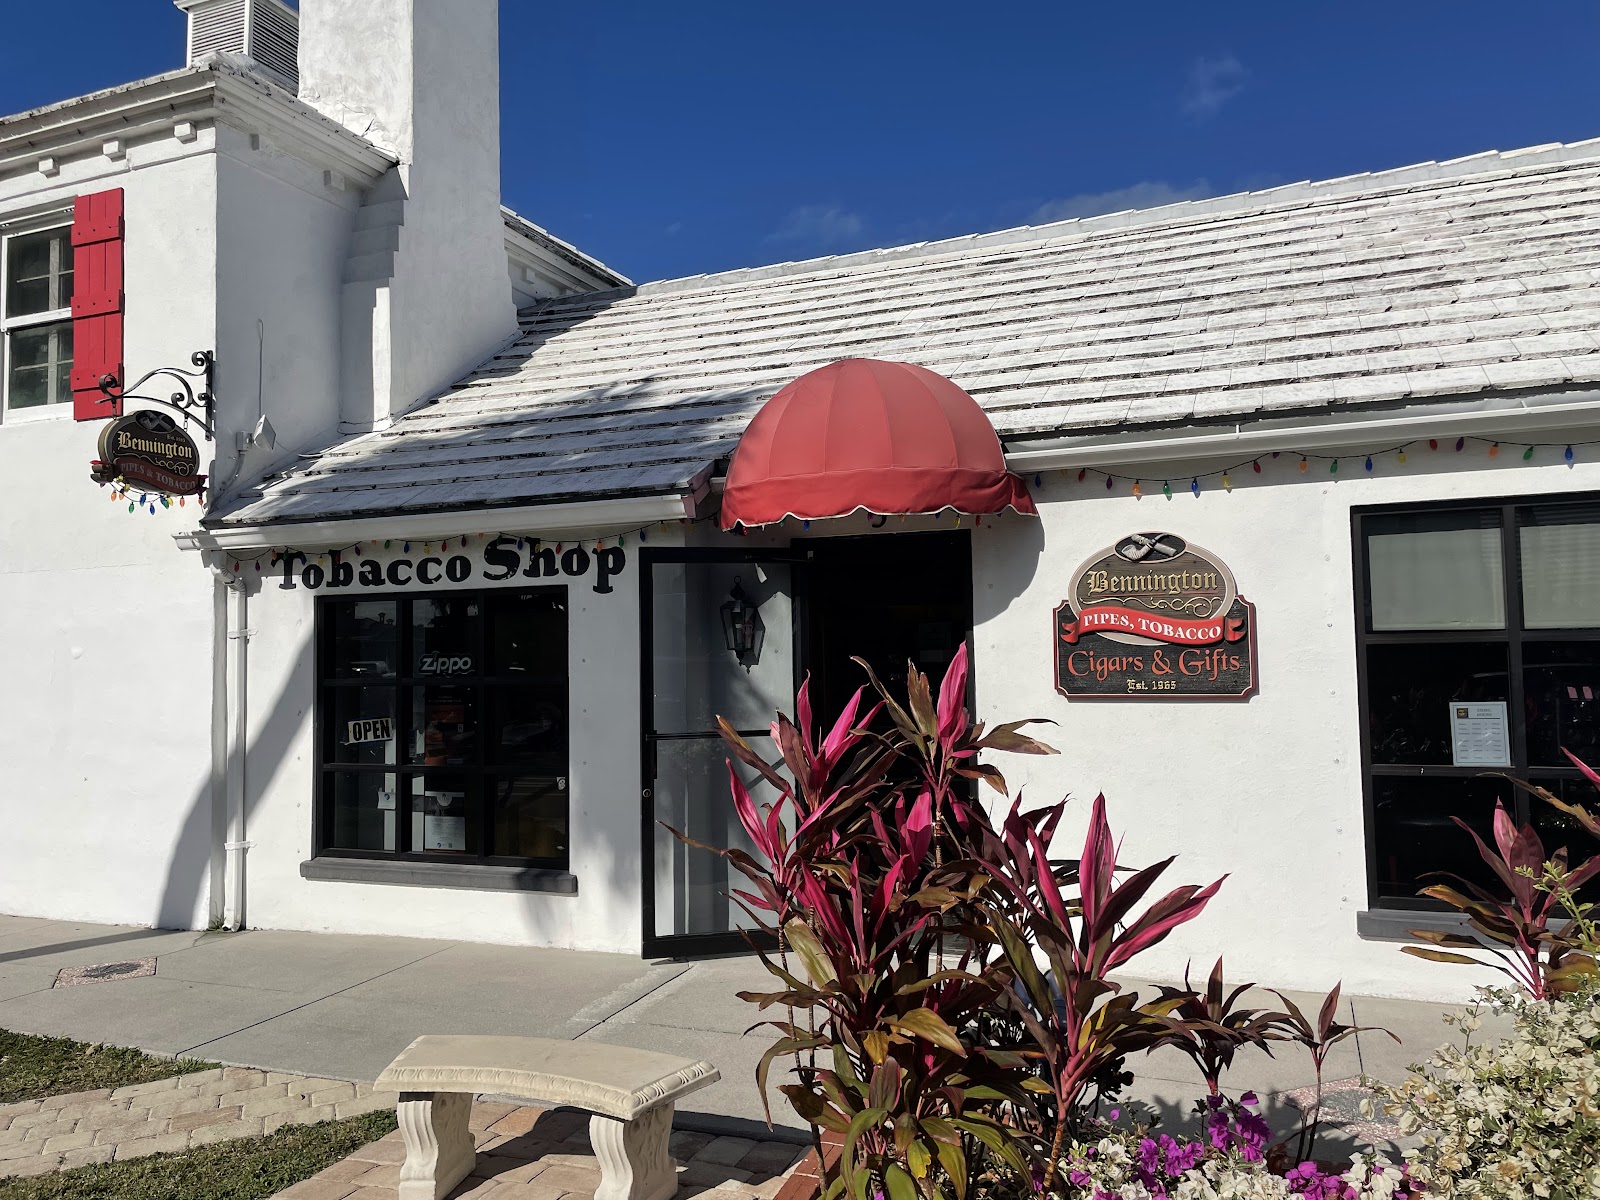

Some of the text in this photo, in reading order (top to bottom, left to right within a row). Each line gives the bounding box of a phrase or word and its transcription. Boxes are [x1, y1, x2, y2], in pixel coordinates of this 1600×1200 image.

[117, 431, 193, 458] Bennington
[120, 462, 196, 490] PIPES & TOBACCO
[270, 536, 626, 594] Tobacco Shop
[1086, 569, 1219, 597] Bennington
[1083, 612, 1222, 640] PIPES, TOBACCO
[1067, 648, 1241, 681] Cigars & Gifts
[1126, 678, 1177, 694] Est. 1965
[352, 718, 391, 742] OPEN
